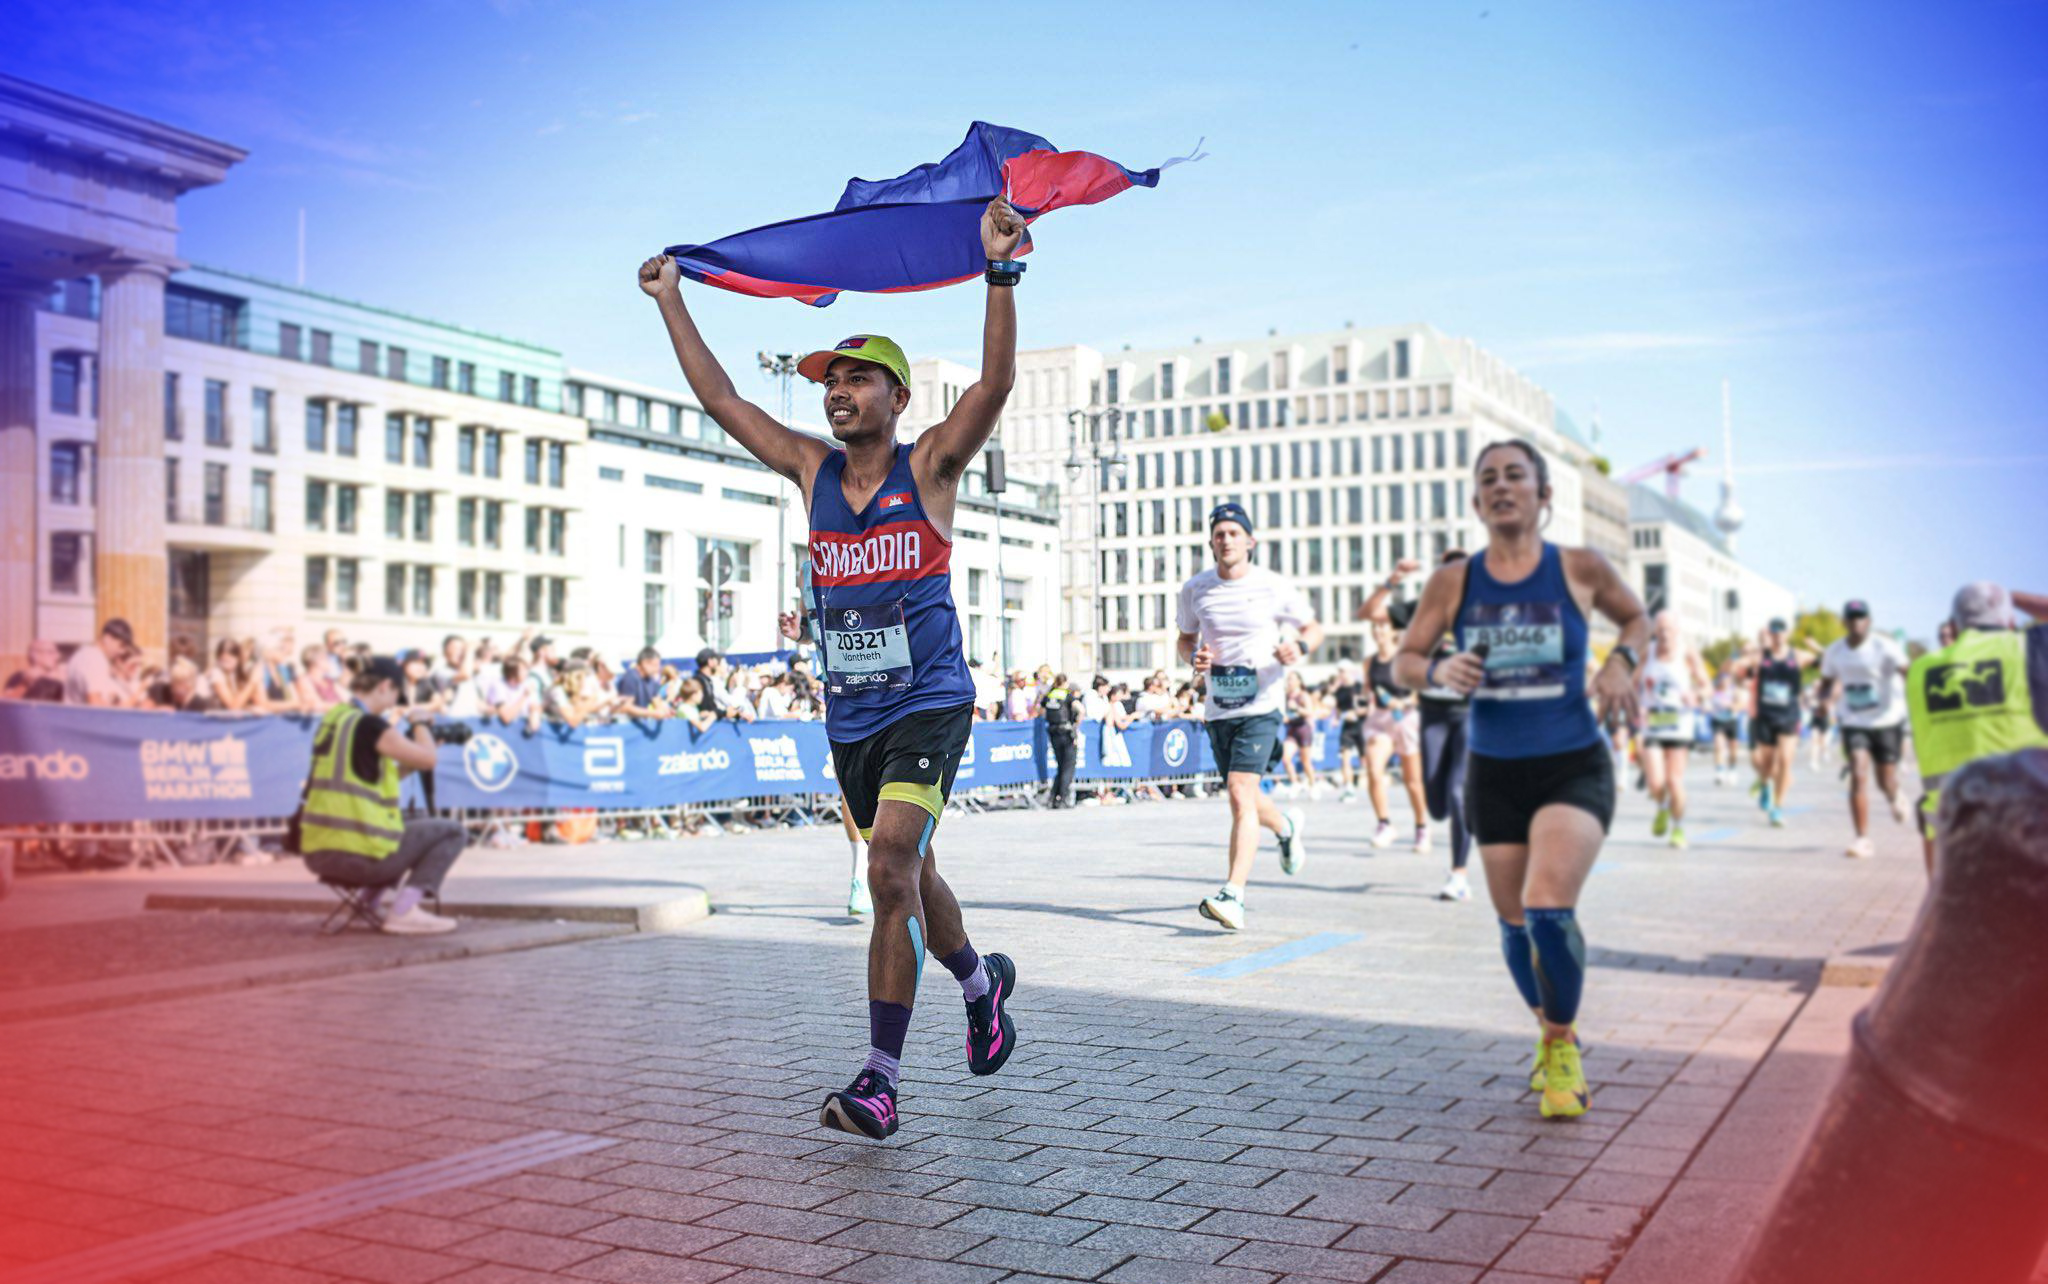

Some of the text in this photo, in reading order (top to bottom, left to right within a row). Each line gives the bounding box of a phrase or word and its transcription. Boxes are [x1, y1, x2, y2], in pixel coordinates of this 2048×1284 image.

[811, 531, 920, 577] CAMBODIA
[836, 630, 887, 650] 20321
[845, 672, 888, 684] zalando
[141, 739, 207, 764] BMW
[658, 748, 730, 775] zalando
[146, 782, 252, 800] MARATHON
